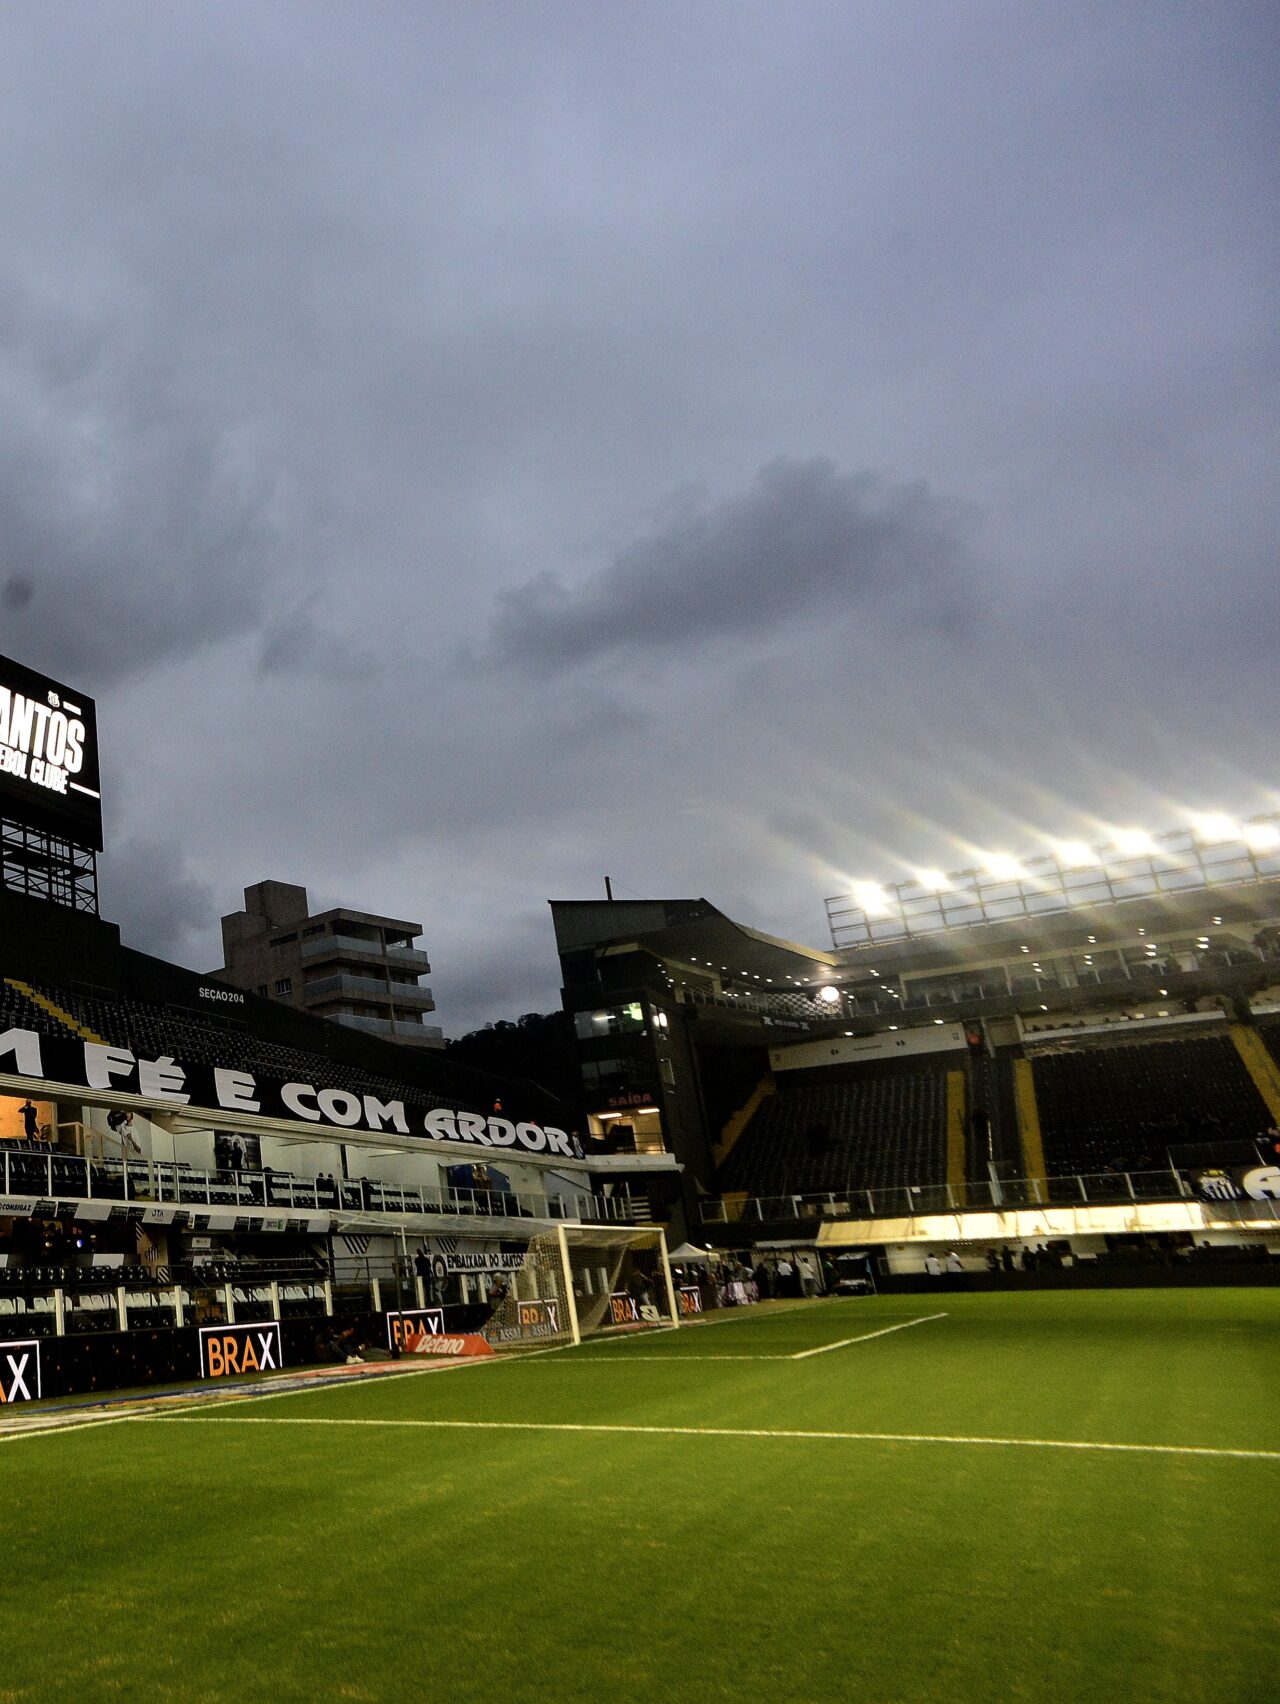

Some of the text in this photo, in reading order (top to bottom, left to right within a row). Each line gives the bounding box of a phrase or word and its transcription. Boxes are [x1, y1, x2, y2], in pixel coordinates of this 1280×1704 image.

[30, 757, 69, 795] CLUBE
[228, 992, 245, 1004] 204
[84, 1041, 191, 1105] FÉ
[214, 1067, 261, 1112] E
[281, 1082, 410, 1133] COM
[424, 1108, 574, 1157] ARDOR
[1, 1203, 32, 1211] CONSIGAZ
[489, 1254, 499, 1267] DO
[612, 1296, 640, 1324] BRAX
[207, 1332, 273, 1377] BRAX
[415, 1333, 466, 1355] Betano
